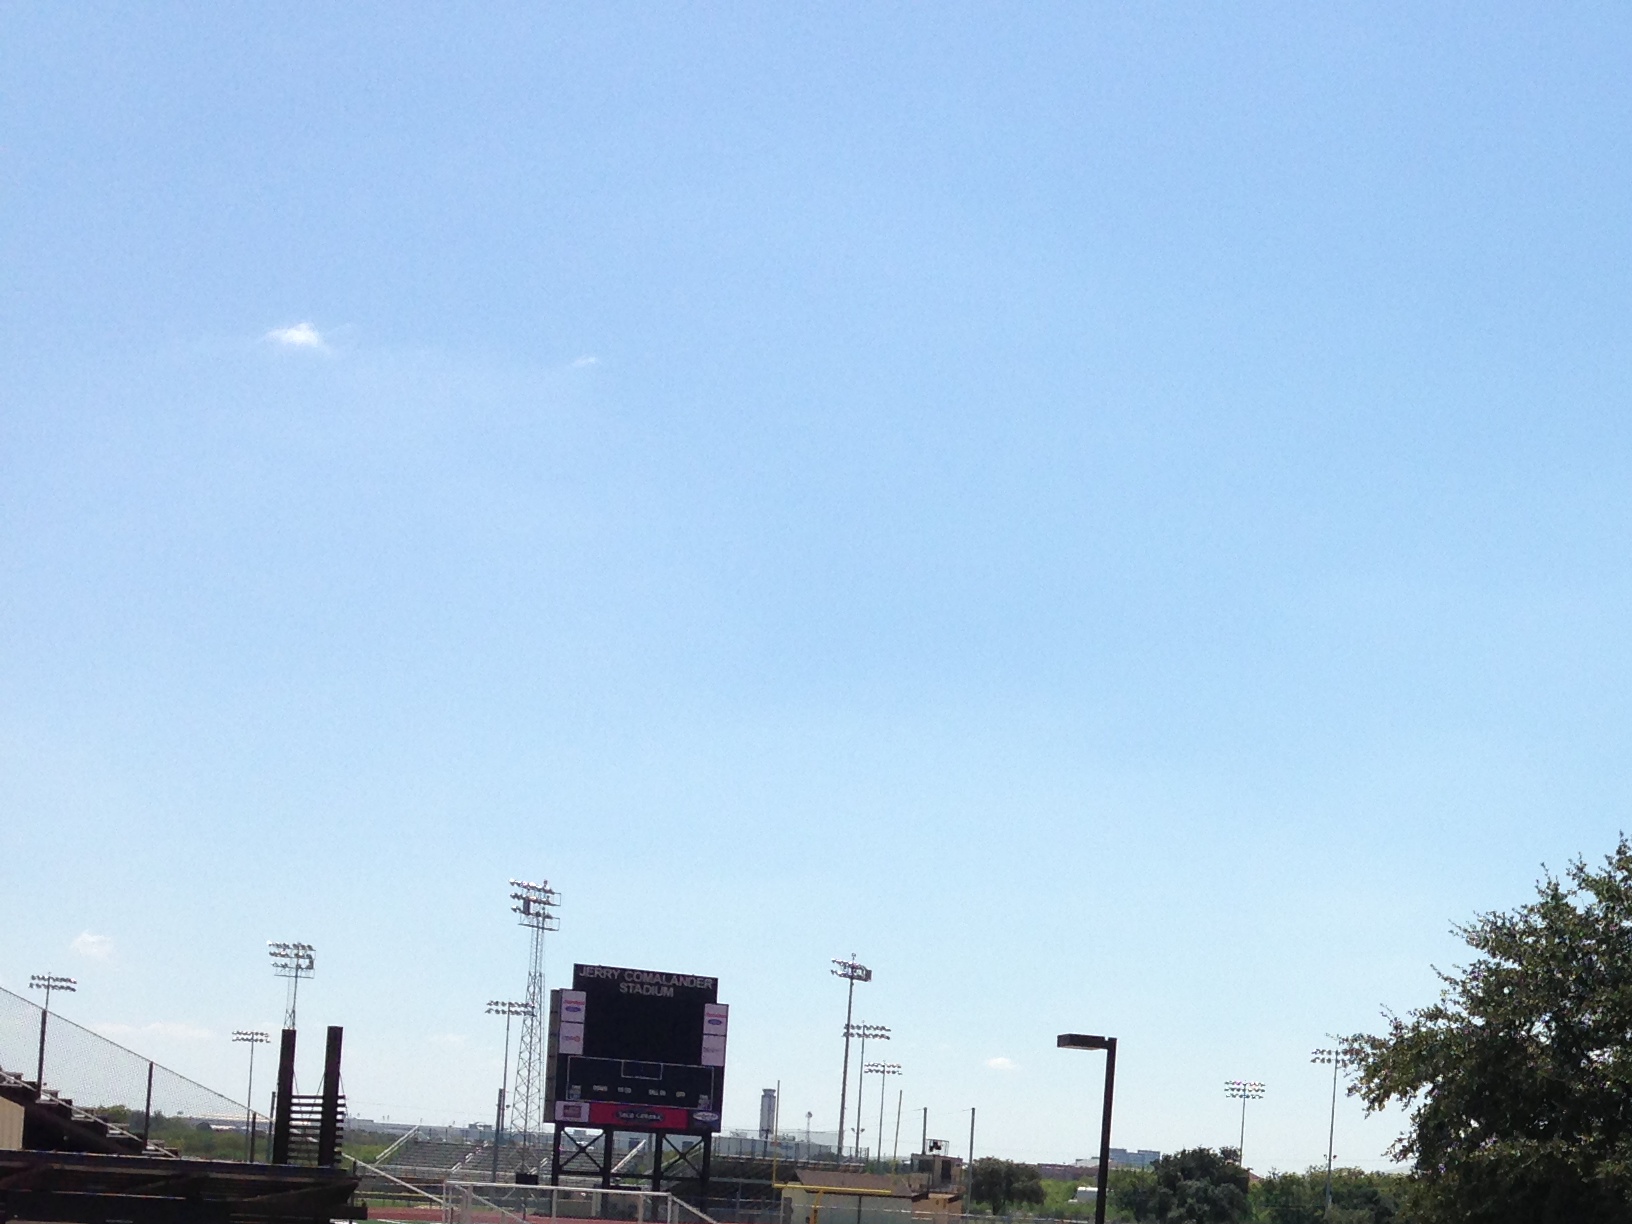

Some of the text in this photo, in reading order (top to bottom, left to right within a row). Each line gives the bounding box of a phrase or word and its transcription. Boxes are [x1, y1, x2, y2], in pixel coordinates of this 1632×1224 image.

[579, 966, 713, 989] JERRY COMALANDER
[619, 982, 674, 998] STADIUM
